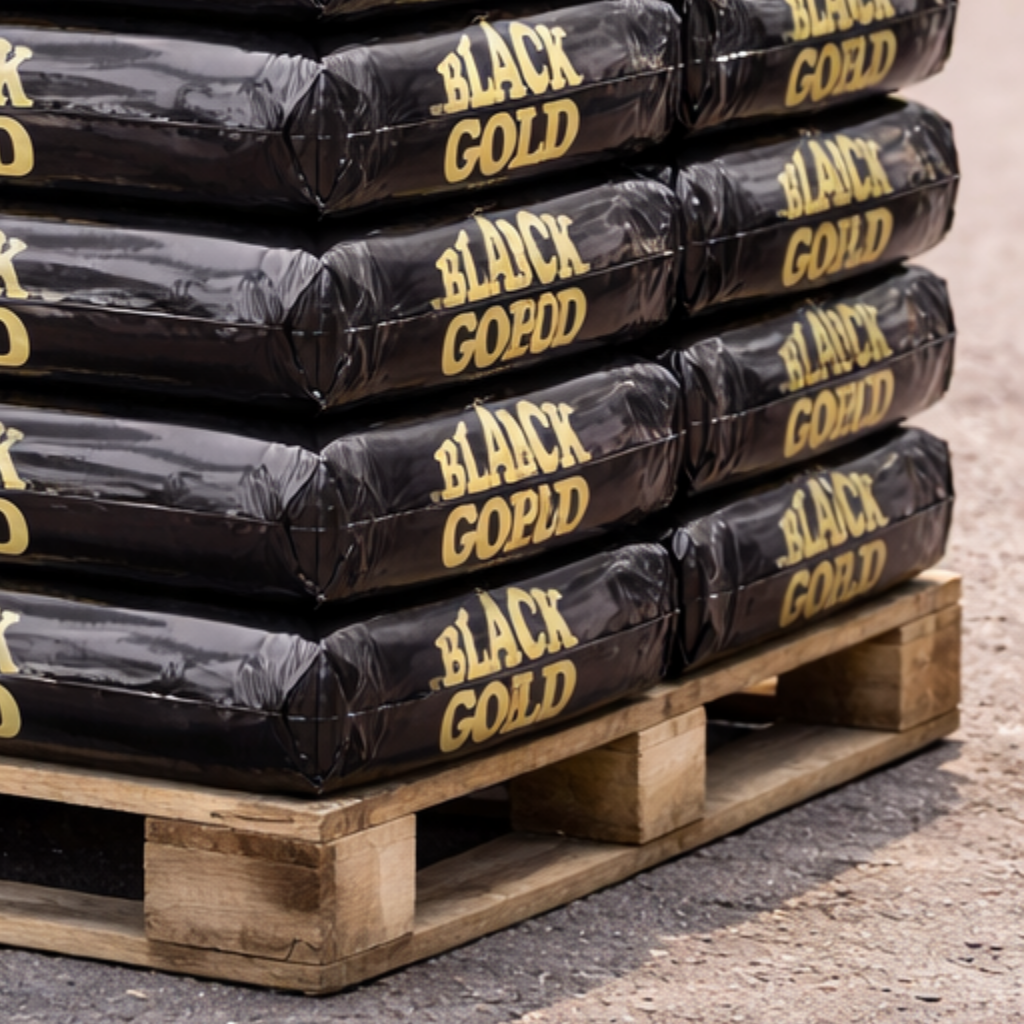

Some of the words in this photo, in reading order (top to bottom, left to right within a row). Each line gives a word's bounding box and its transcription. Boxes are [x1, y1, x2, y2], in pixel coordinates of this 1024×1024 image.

[430, 20, 584, 116] BLACK
[444, 98, 580, 183] GOLD
[429, 586, 579, 690] BLACK
